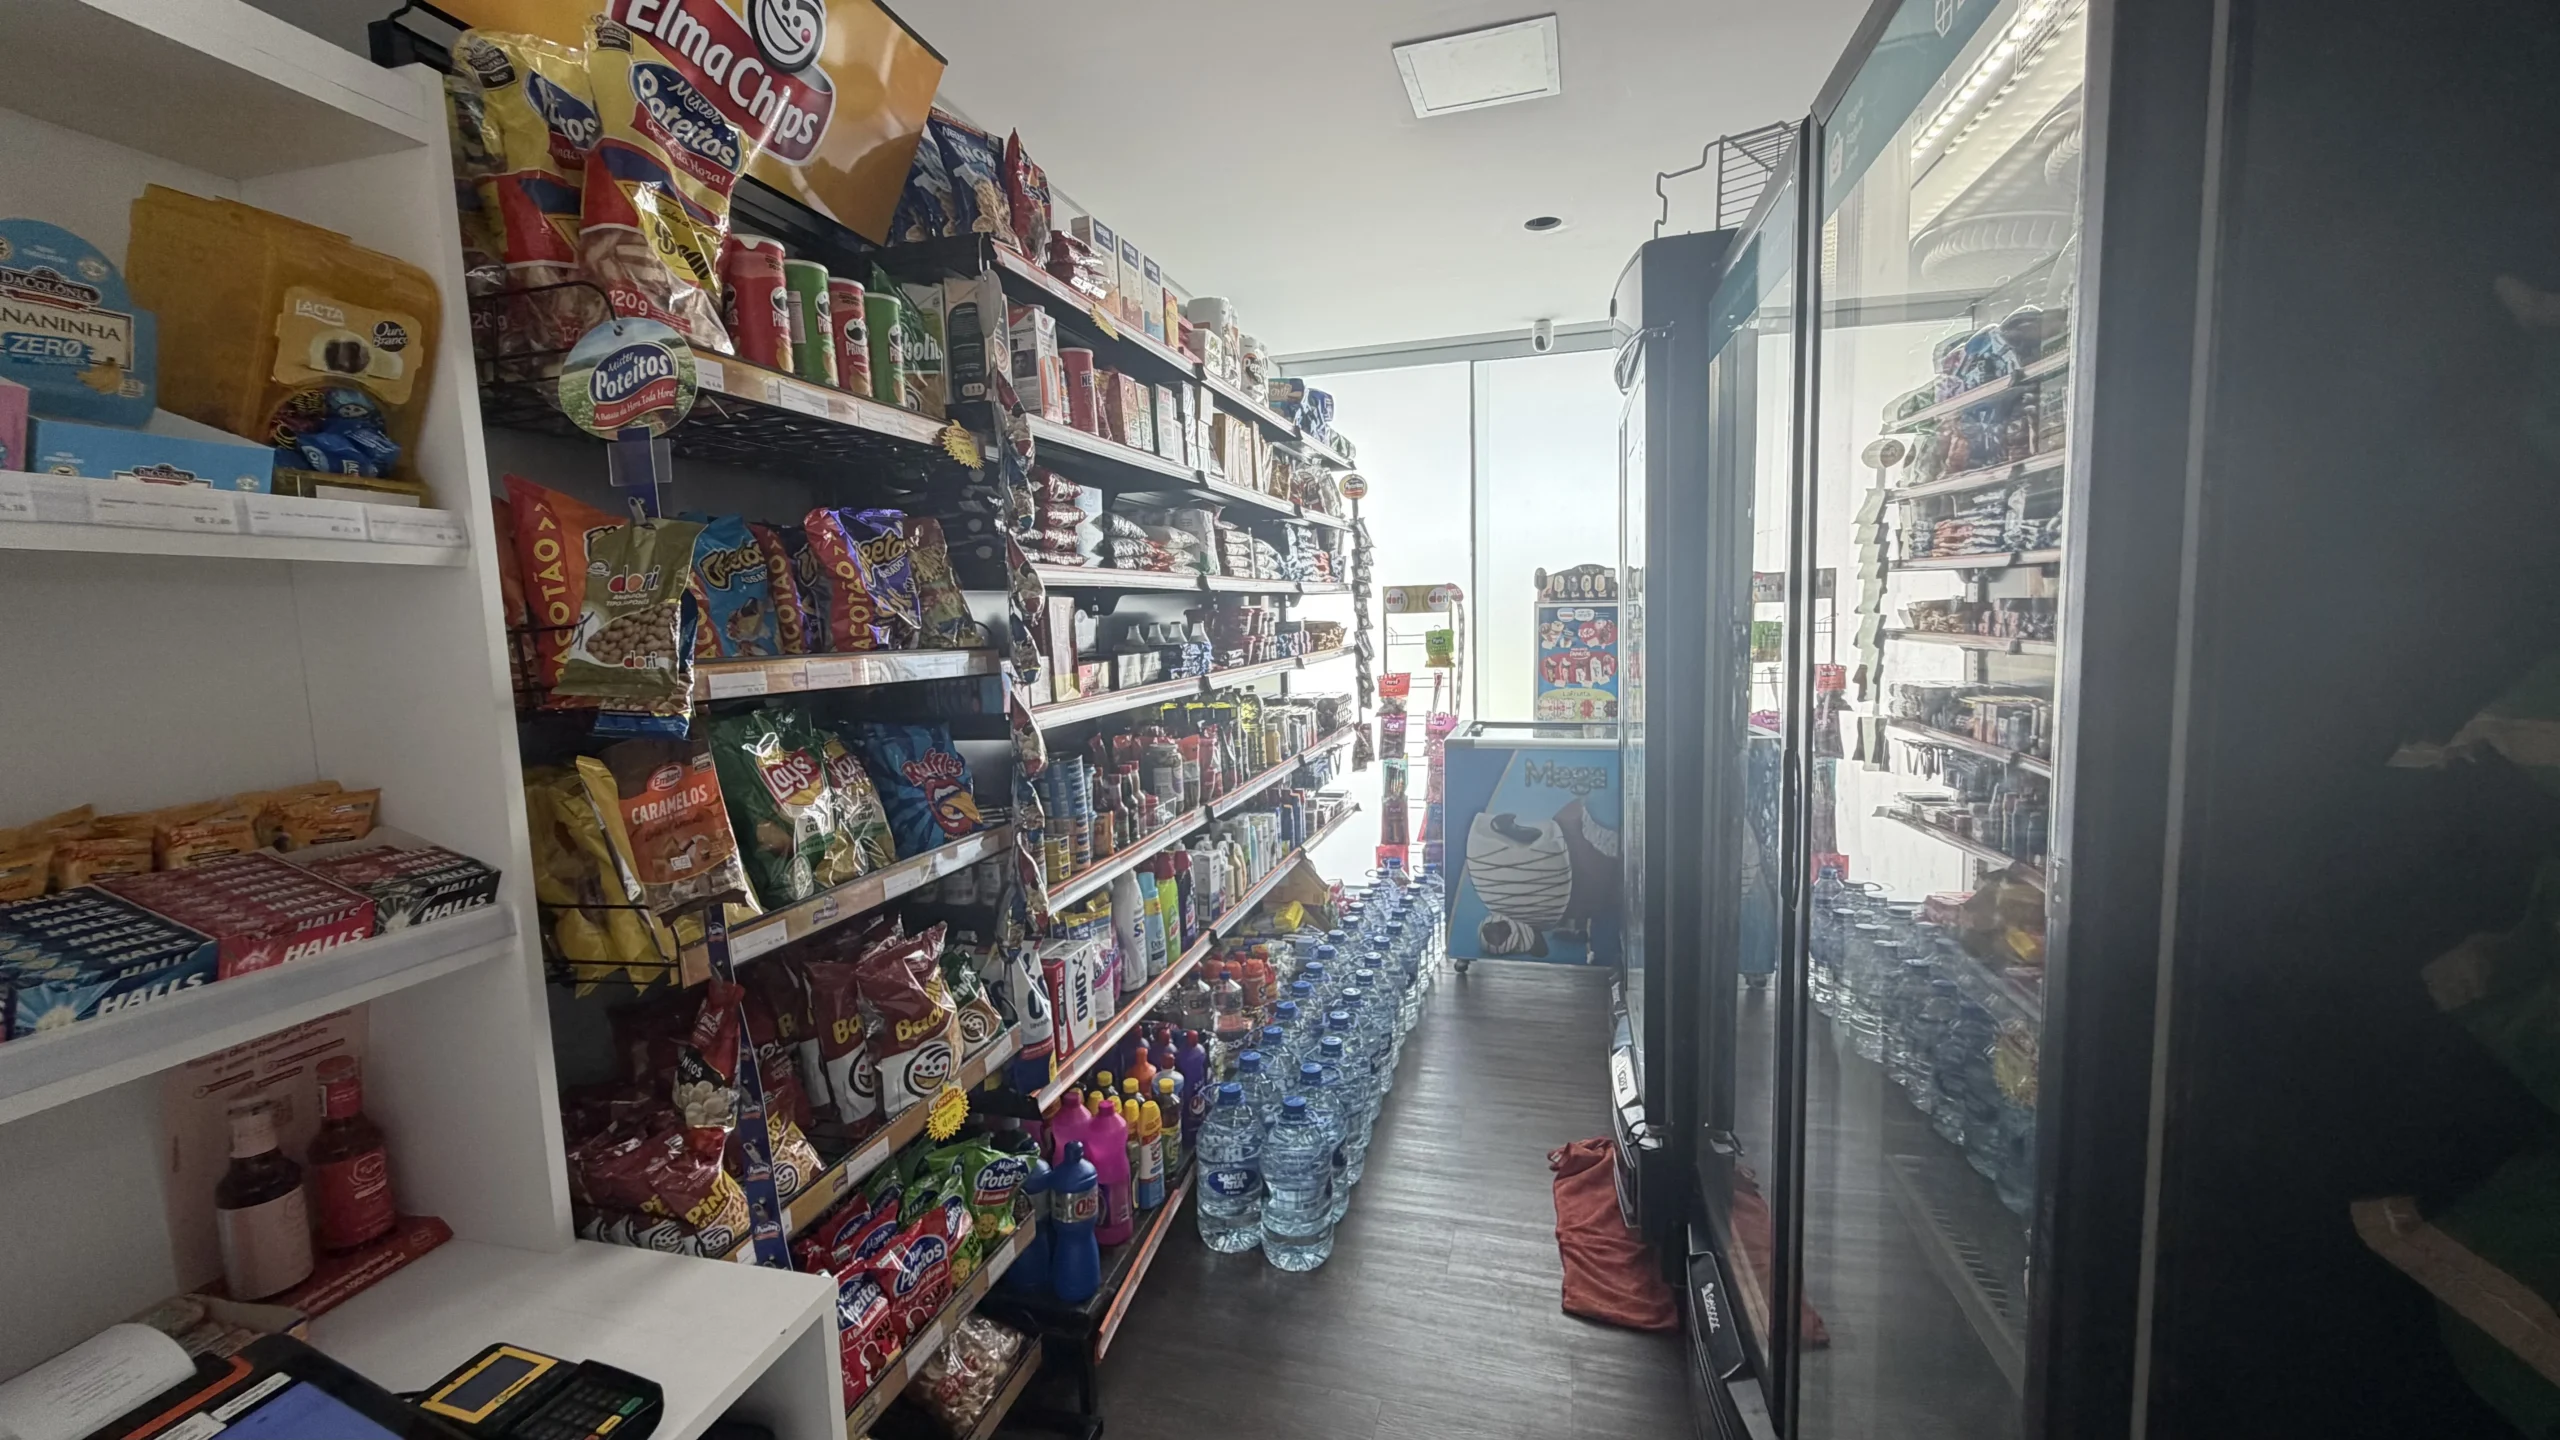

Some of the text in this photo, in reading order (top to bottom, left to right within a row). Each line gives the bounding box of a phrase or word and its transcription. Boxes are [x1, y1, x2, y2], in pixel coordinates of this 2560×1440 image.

[0, 307, 122, 343] NANINHA
[294, 298, 345, 325] LACTA
[372, 321, 408, 338] Ouro
[594, 353, 670, 401] Poteitos
[607, 351, 635, 373] Mister
[607, 564, 662, 594] dori
[1386, 592, 1404, 605] dori
[622, 651, 658, 670] dori
[762, 754, 813, 801] Lay's
[900, 747, 966, 788] Ruffles
[1524, 758, 1607, 796] Mega
[631, 784, 708, 826] CARAMELOS
[420, 892, 489, 923] HALLS
[281, 926, 366, 965] HALLS
[96, 971, 206, 1018] HALLS
[1075, 974, 1089, 1023] OMO
[1217, 1171, 1249, 1183] SANTA
